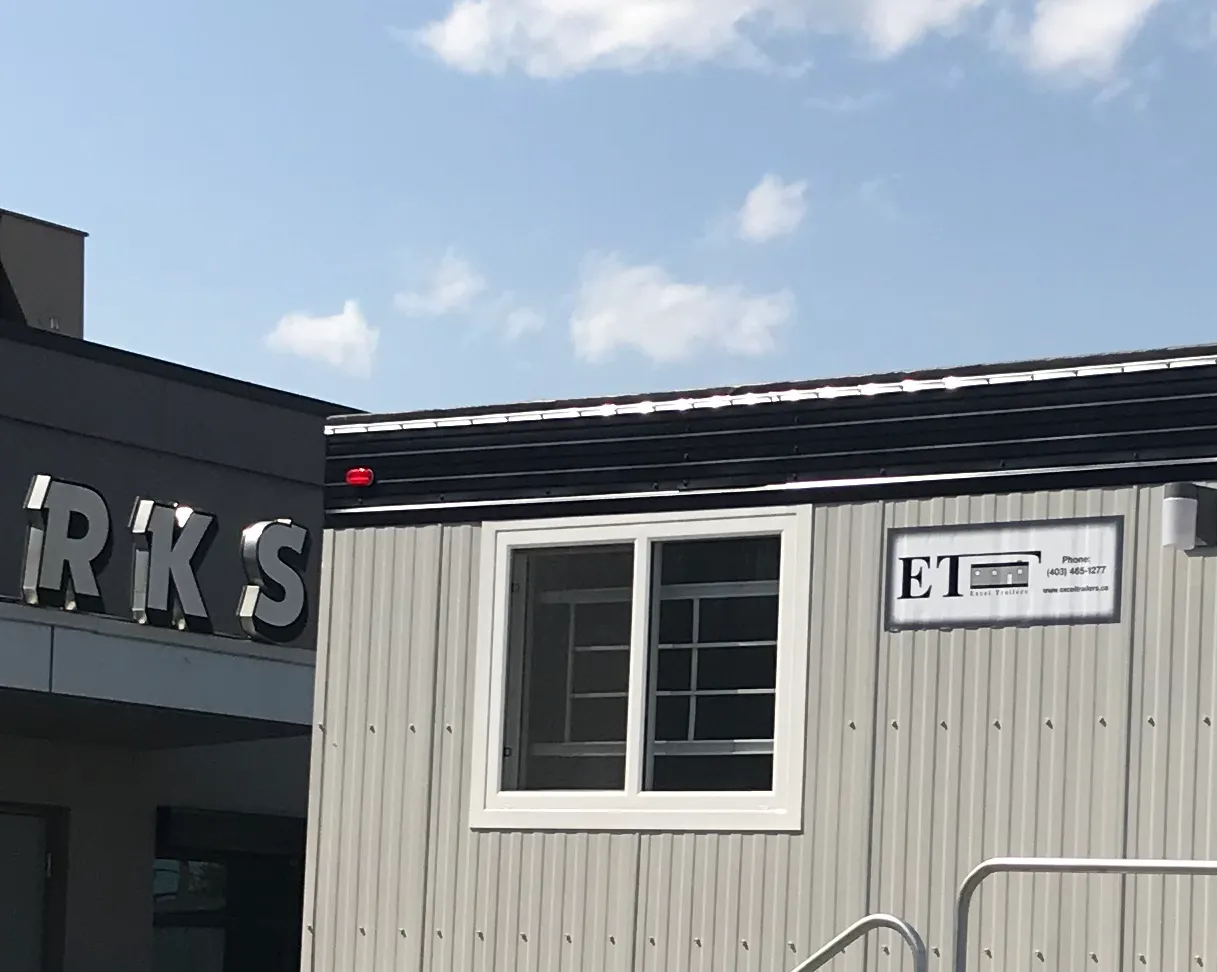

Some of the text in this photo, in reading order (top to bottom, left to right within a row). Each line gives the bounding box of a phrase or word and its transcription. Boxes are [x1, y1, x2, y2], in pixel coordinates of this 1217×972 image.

[23, 474, 310, 640] RKS
[1062, 556, 1091, 564] Phone:
[1047, 567, 1067, 577] (403)
